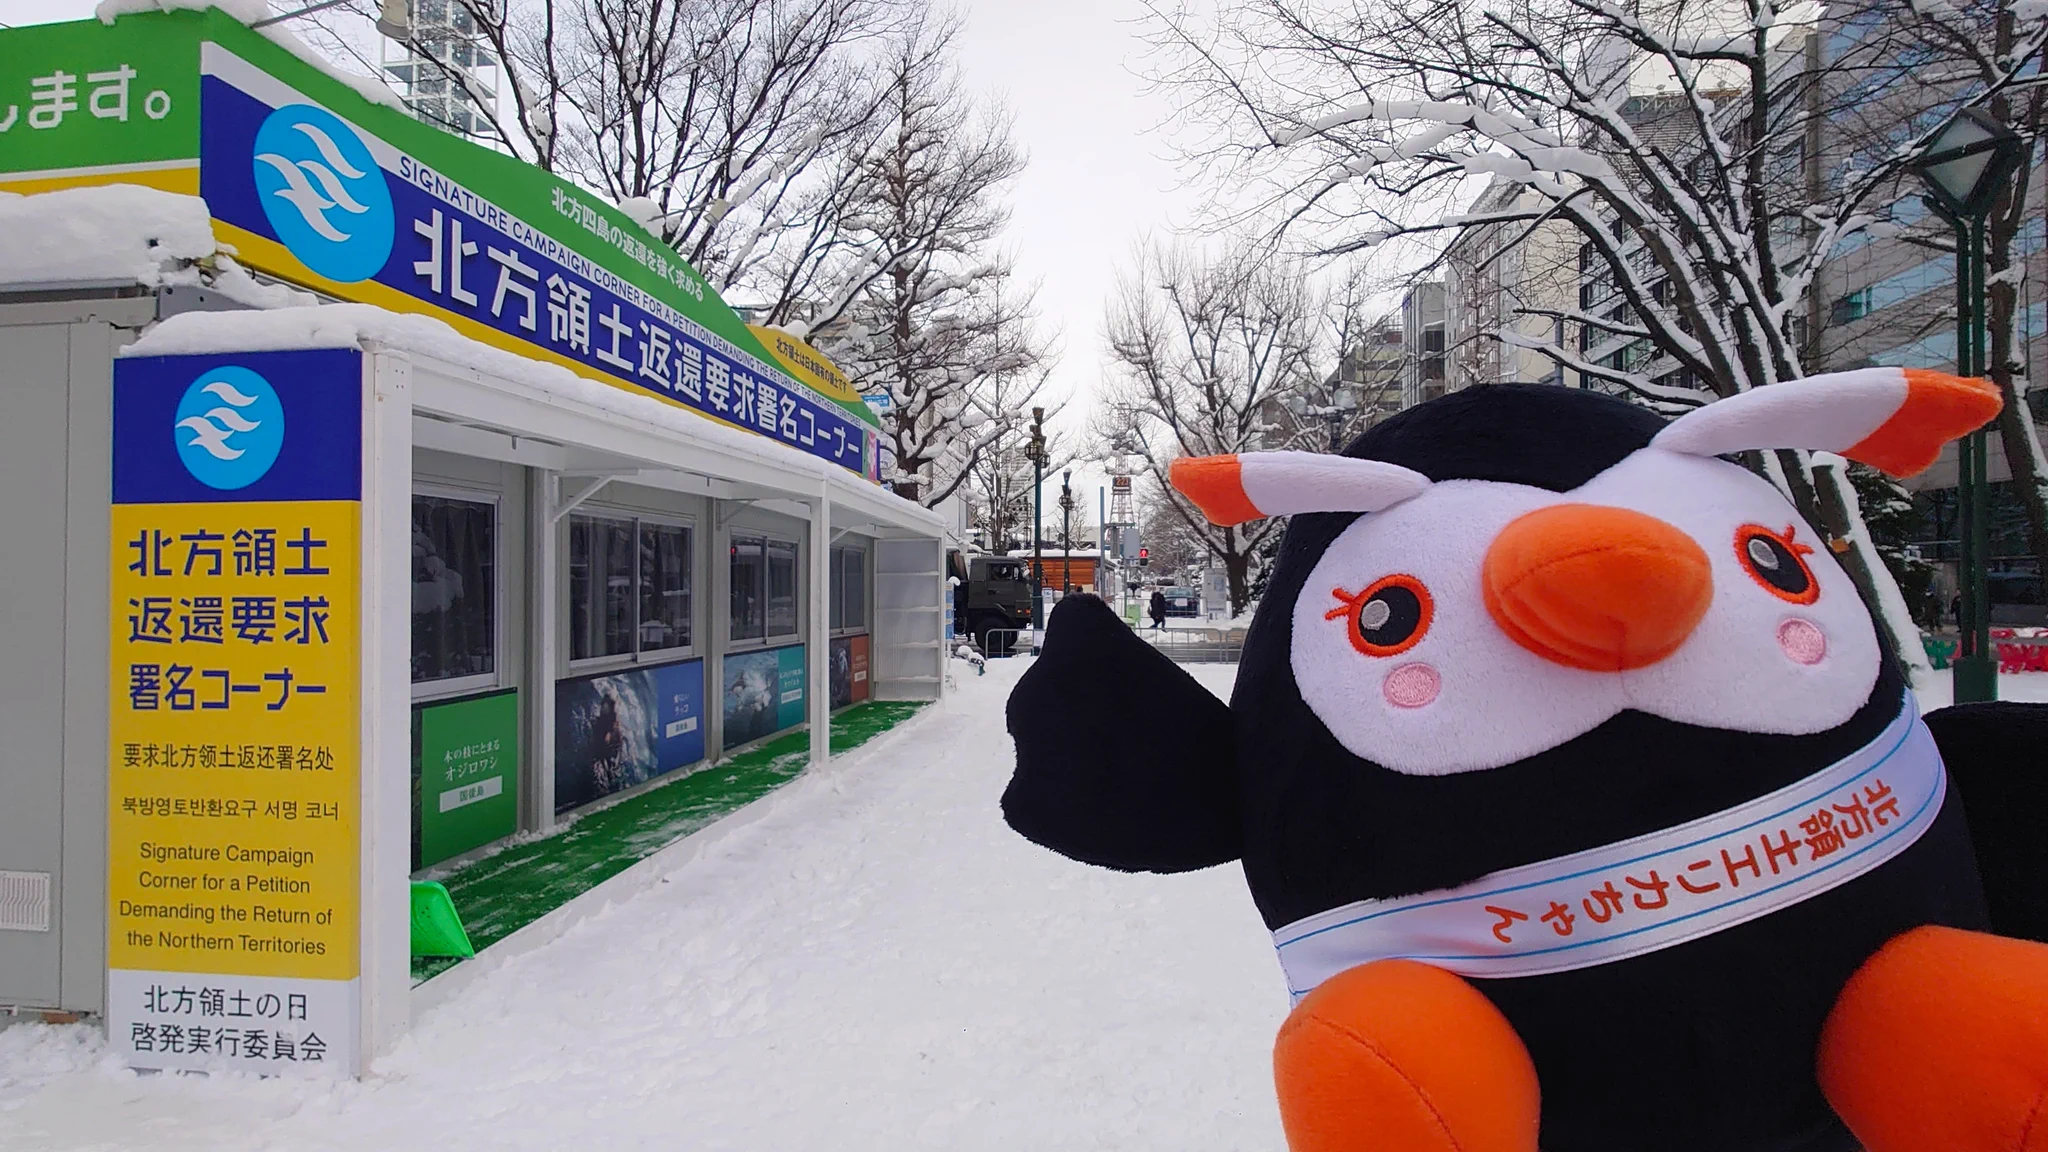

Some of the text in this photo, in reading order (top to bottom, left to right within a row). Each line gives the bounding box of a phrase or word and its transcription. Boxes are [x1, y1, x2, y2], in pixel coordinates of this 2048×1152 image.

[551, 186, 704, 302] 北方四島の返還を強く求める
[399, 155, 508, 233] SIGNATURE
[513, 221, 591, 277] CAMPAIGN
[594, 268, 640, 305] CORNER
[643, 295, 662, 318] FOR
[664, 309, 671, 322] A
[672, 312, 712, 346] PETITION
[713, 335, 754, 369] DEMANDING
[756, 360, 769, 377] THE
[769, 367, 793, 390] RETURN
[793, 380, 800, 393] OF
[800, 385, 811, 401] THE
[412, 207, 860, 458] 北方領土返還要求署名コーナー
[128, 527, 330, 577] 北方領土
[128, 595, 330, 645] 返還要求
[129, 663, 327, 711] 署名コーナー
[123, 743, 335, 771] 要求北方领土返还署名处
[445, 756, 499, 782] オジロワシ
[122, 797, 340, 821] 북방영토반환요구 서명 코너
[140, 842, 315, 867] Signature Campaign
[1484, 778, 1901, 943] 北方領土エリカちゃん
[139, 871, 311, 893] Corner for a Petition
[119, 900, 333, 925] Demanding the Return of
[127, 931, 326, 955] the Northern Territories
[144, 984, 308, 1021] 北方領土の日
[131, 1022, 327, 1061] 啓発実行委員会
